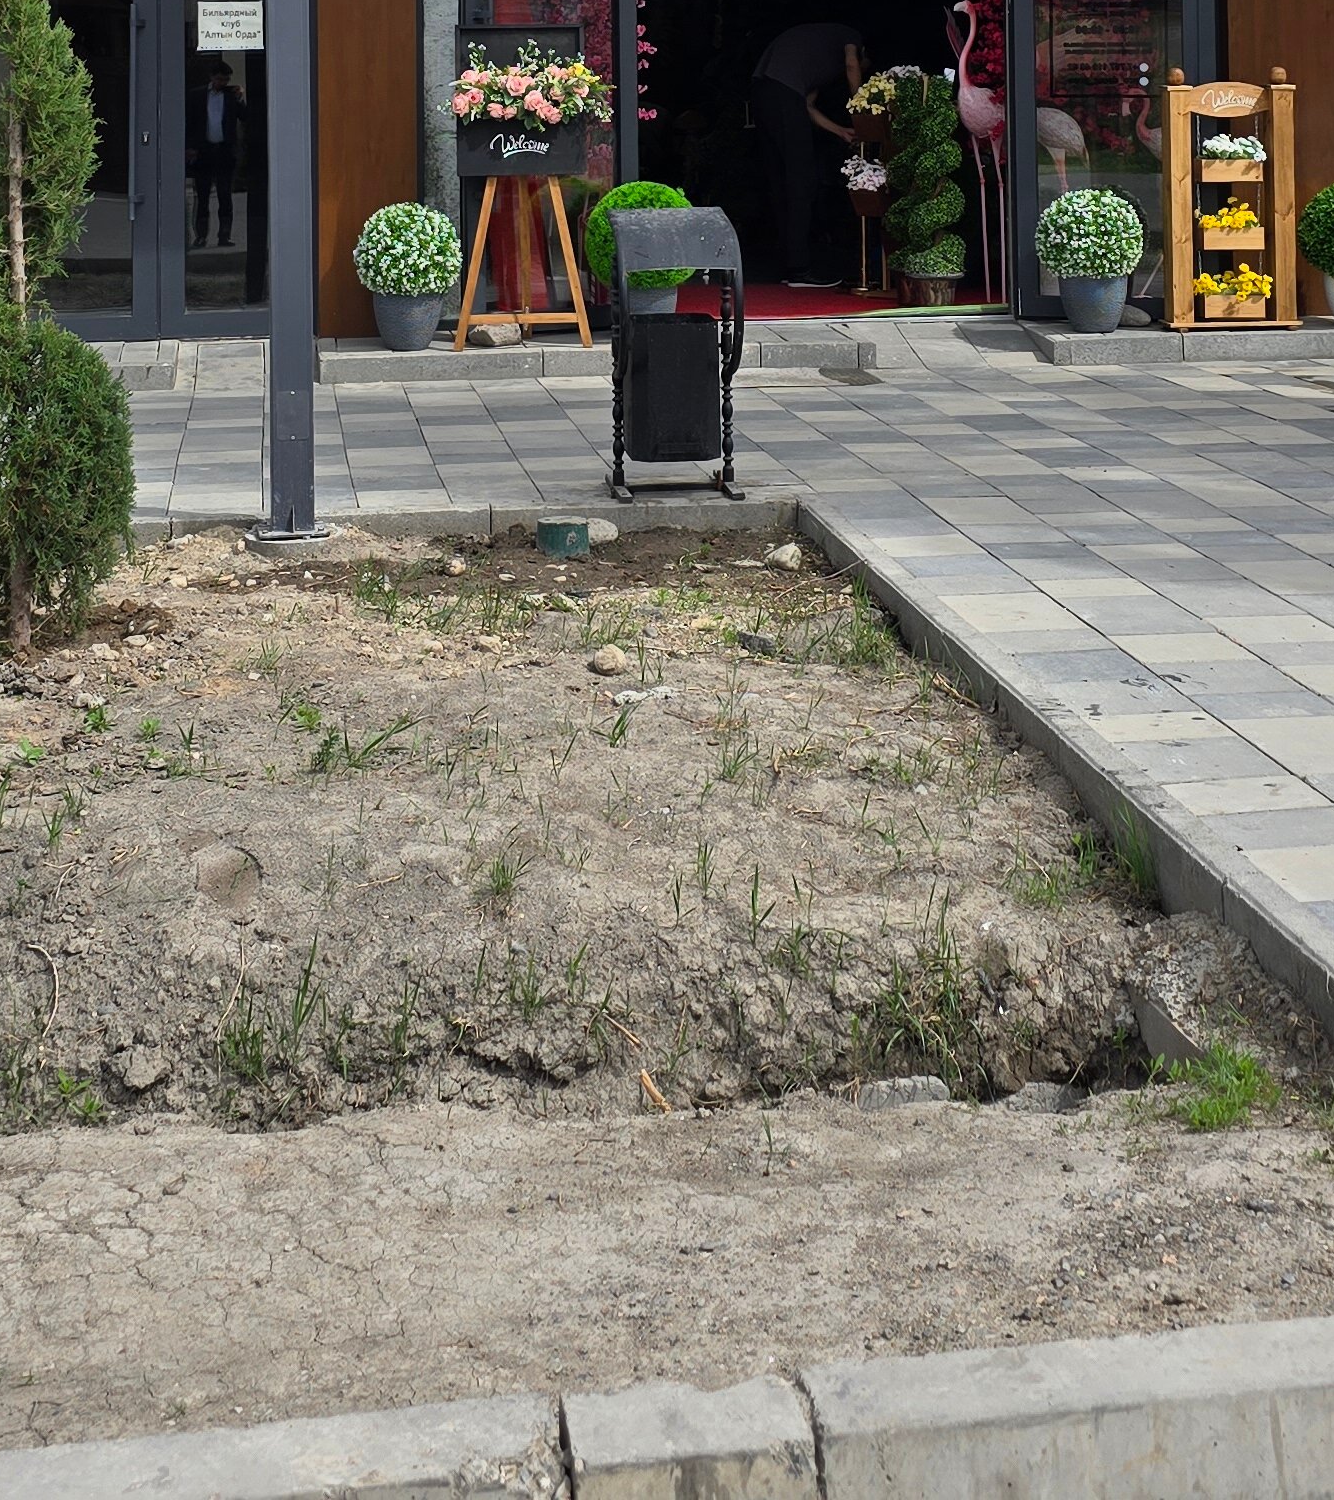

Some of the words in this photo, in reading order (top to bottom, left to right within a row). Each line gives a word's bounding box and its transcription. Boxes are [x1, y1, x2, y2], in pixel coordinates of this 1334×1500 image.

[202, 8, 258, 19] Бильярдный
[221, 19, 241, 29] клуб
[1201, 89, 1258, 113] Welcome
[489, 133, 550, 159] Welcome
